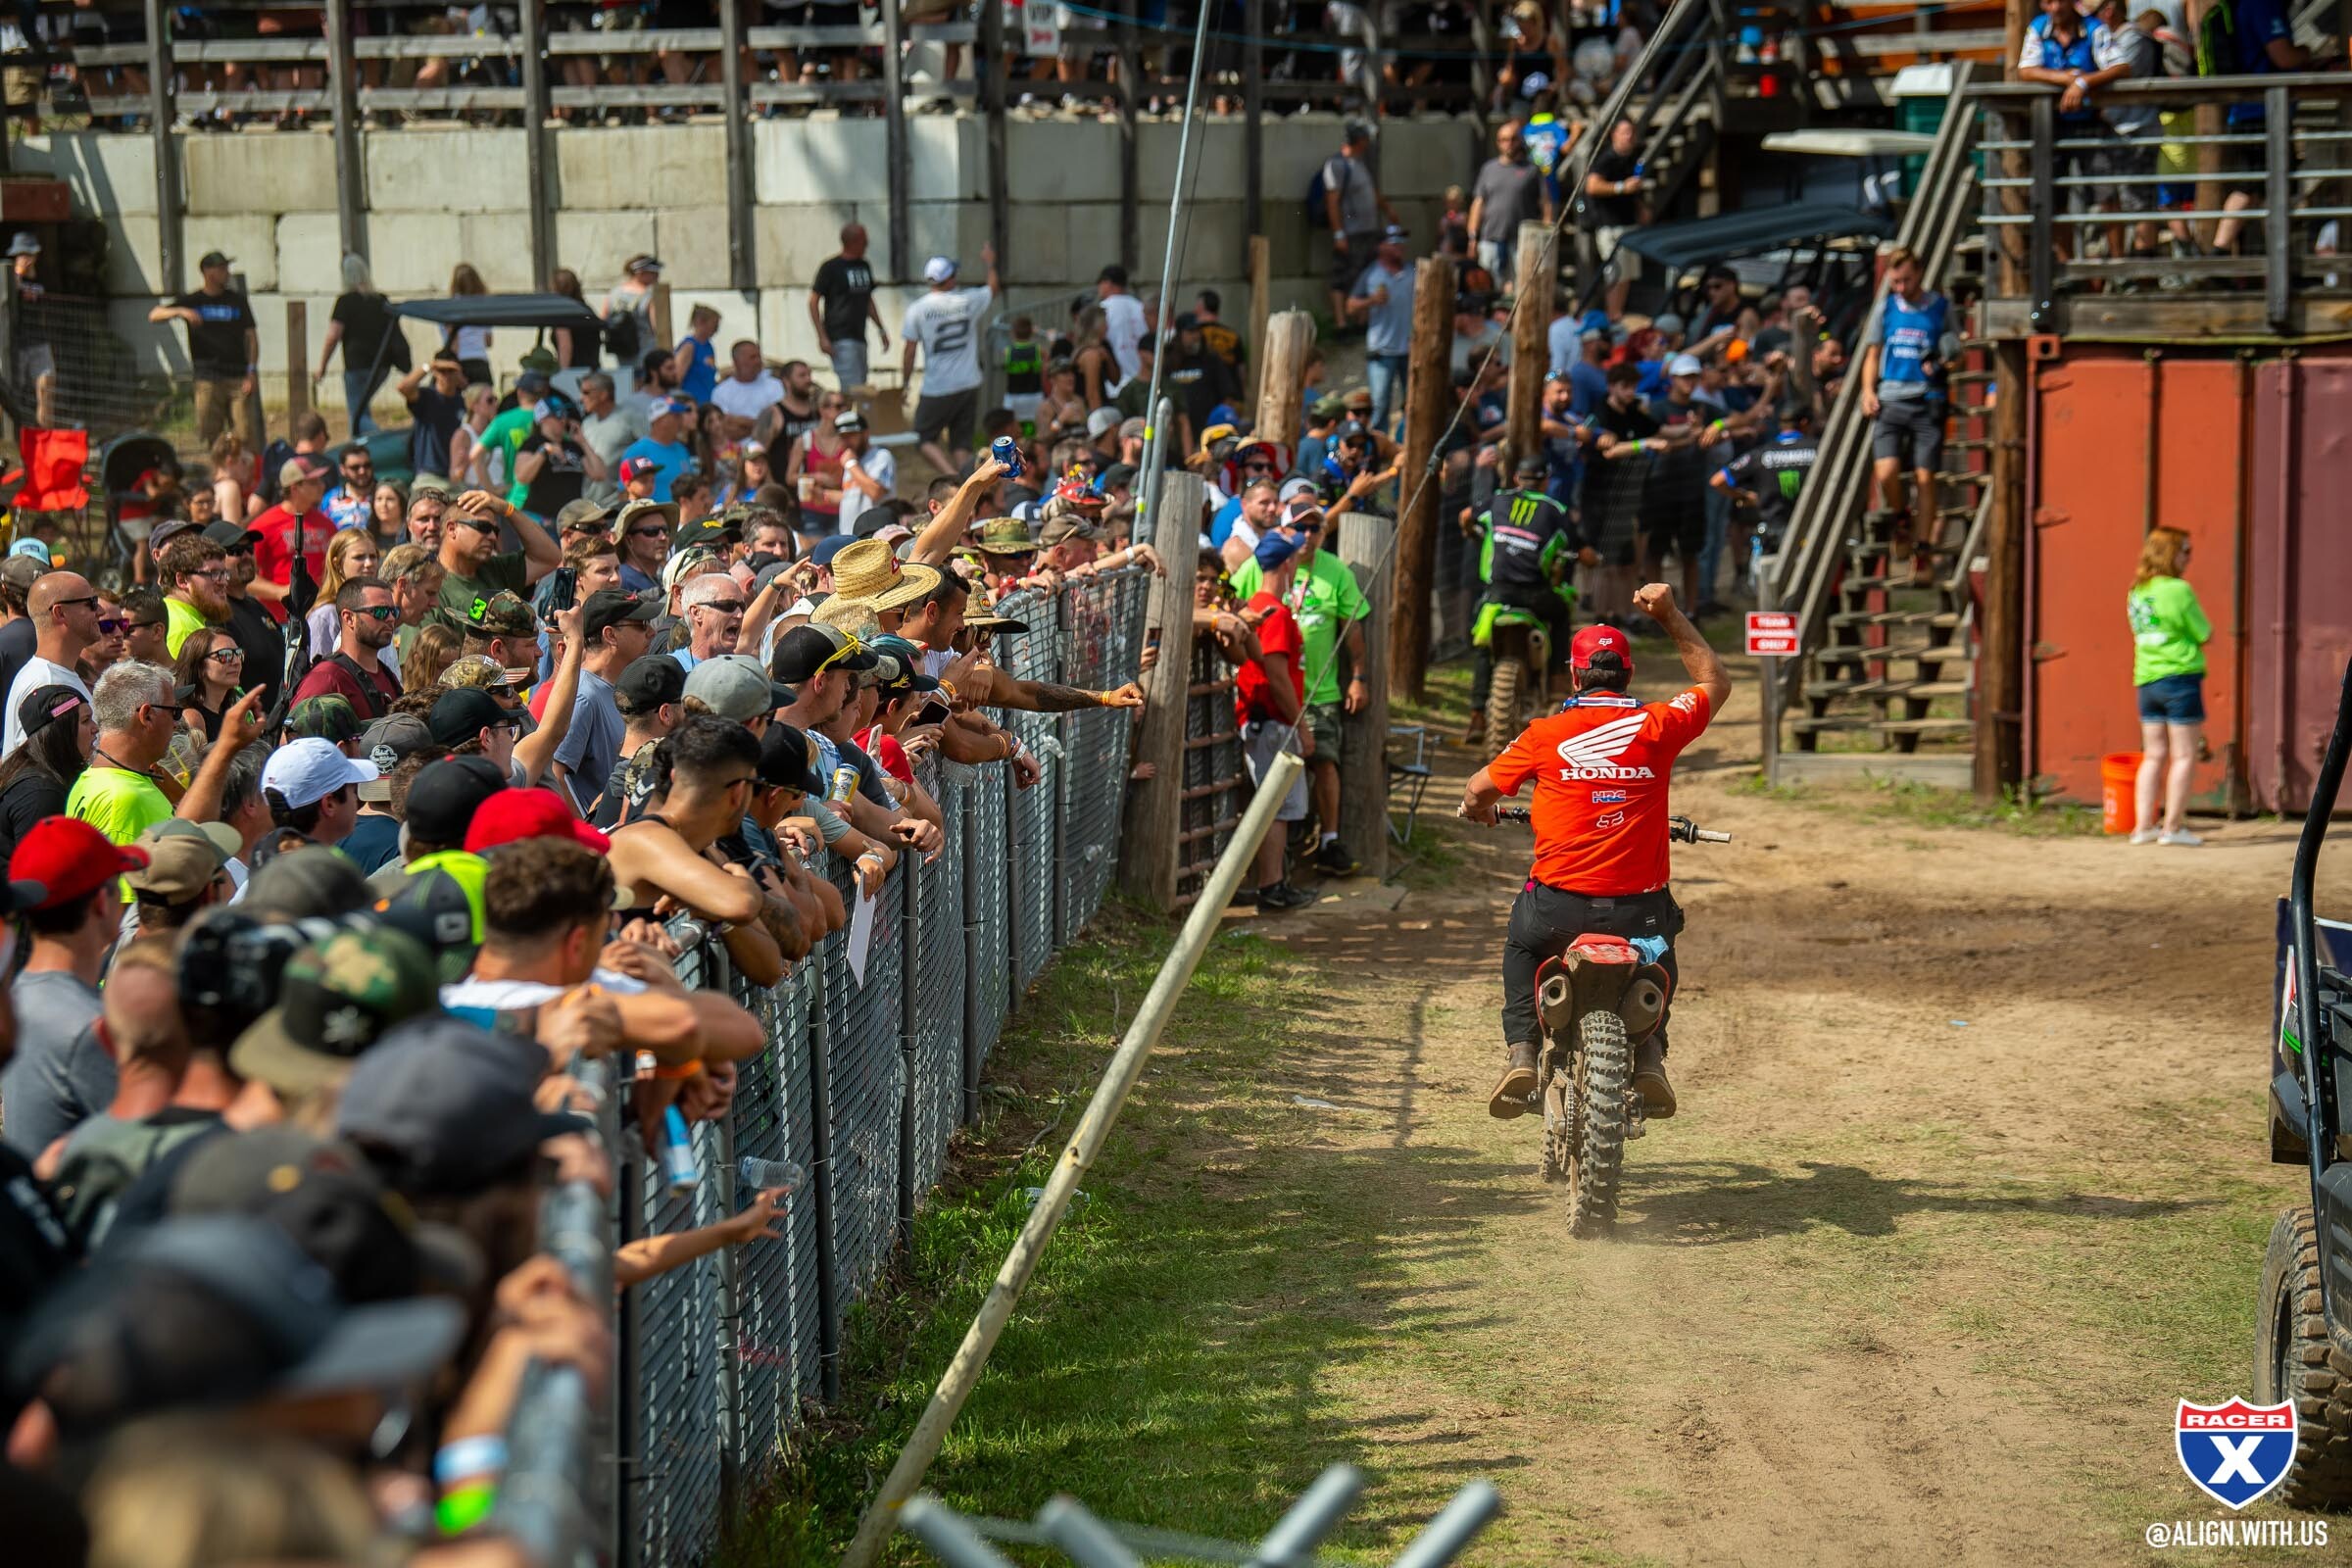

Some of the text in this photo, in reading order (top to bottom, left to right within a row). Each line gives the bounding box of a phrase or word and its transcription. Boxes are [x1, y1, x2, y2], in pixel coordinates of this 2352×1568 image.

[934, 318, 970, 355] 2
[468, 597, 488, 620] 3
[1559, 765, 1655, 781] HONDA
[1592, 790, 1627, 804] HRC
